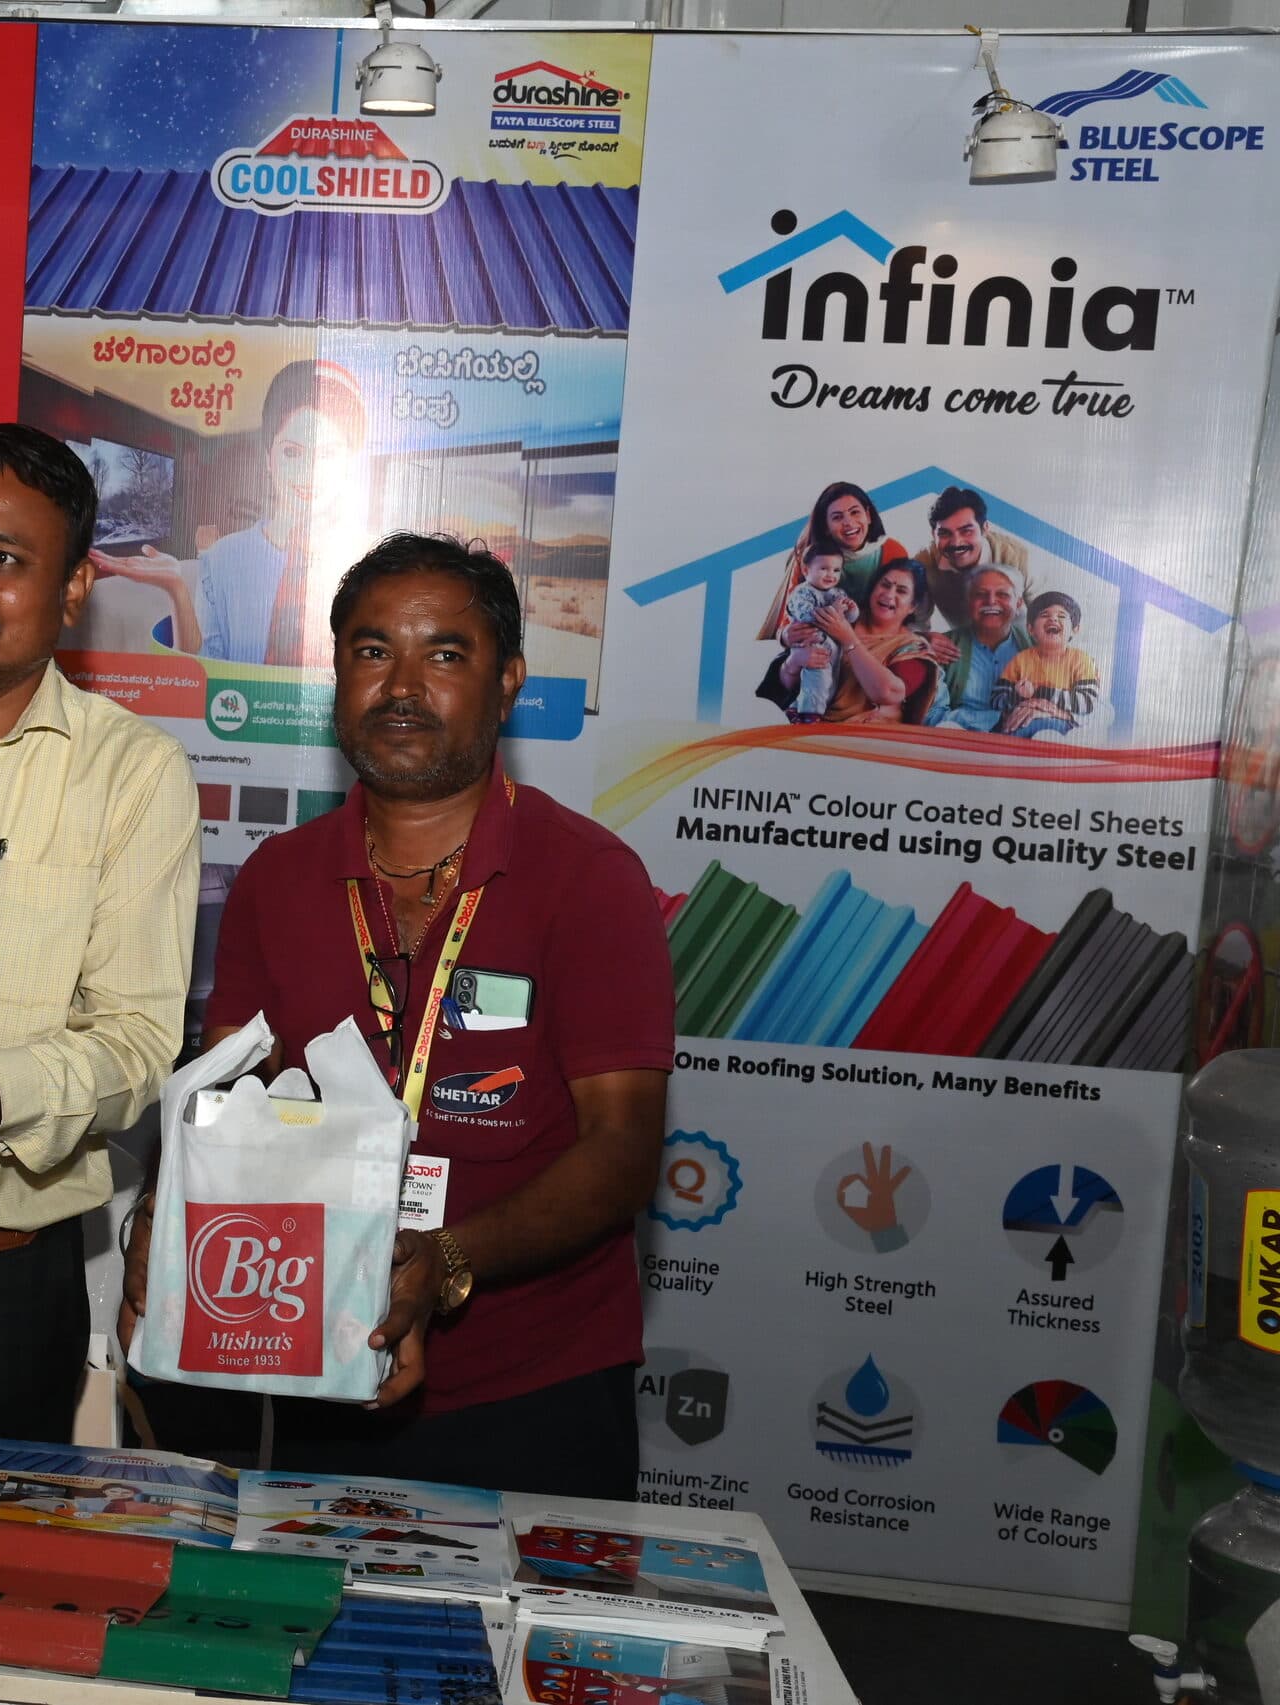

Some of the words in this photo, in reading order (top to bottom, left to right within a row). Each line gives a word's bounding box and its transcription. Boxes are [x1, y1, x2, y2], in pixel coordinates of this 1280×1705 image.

[493, 78, 619, 107] durashine
[290, 127, 374, 142] DURASHINE
[495, 116, 524, 126] TATA
[587, 119, 617, 129] STEEL
[230, 163, 431, 200] COOLSHIELD
[1070, 157, 1160, 183] STEEL
[761, 209, 1160, 353] infinia
[93, 336, 243, 379] ಚಳಿಗಾಲದಲ್ಲಿ
[170, 381, 234, 427] ಬೆಚ್ಚಗೆ
[771, 363, 931, 412] Dreams
[945, 385, 1039, 416] come
[1042, 370, 1135, 419] true
[809, 794, 898, 820] Colour
[905, 799, 1003, 828] Coated
[1012, 805, 1080, 832] Steel
[1089, 809, 1183, 838] Sheets
[675, 816, 889, 852] Manufactured
[898, 833, 982, 864] using
[992, 835, 1107, 872] Quality
[1116, 842, 1196, 873] Steel
[674, 1051, 720, 1072] One
[727, 1054, 815, 1083] Roofing
[821, 1060, 924, 1090] Solution,
[932, 1070, 997, 1097] Many
[1004, 1074, 1101, 1102] Benefits
[433, 1086, 501, 1106] SHETTAR
[435, 1113, 468, 1124] SHETTAR
[477, 1118, 498, 1127] SONS
[642, 1254, 720, 1276] Genuine
[1257, 1207, 1280, 1335] OMKAR
[213, 1236, 314, 1322] Big
[647, 1271, 714, 1296] Quality
[804, 1271, 848, 1292] High
[854, 1275, 936, 1299] Strength
[845, 1296, 893, 1316] Steel
[1016, 1287, 1094, 1312] Assured
[1007, 1308, 1101, 1334] Thickness
[206, 1331, 293, 1351] Mishra's
[218, 1355, 250, 1366] Since
[254, 1355, 281, 1366] 1933
[677, 1395, 712, 1419] Zn
[639, 1468, 749, 1494] minium-Zinc
[636, 1489, 682, 1507] ated
[688, 1492, 734, 1511] Steel
[787, 1483, 838, 1504] Good
[844, 1488, 935, 1514] Corrosion
[811, 1507, 909, 1532] Resistance
[993, 1503, 1044, 1525] Wide
[1050, 1507, 1111, 1534] Range
[998, 1521, 1019, 1542] of
[1024, 1525, 1098, 1551] Colours
